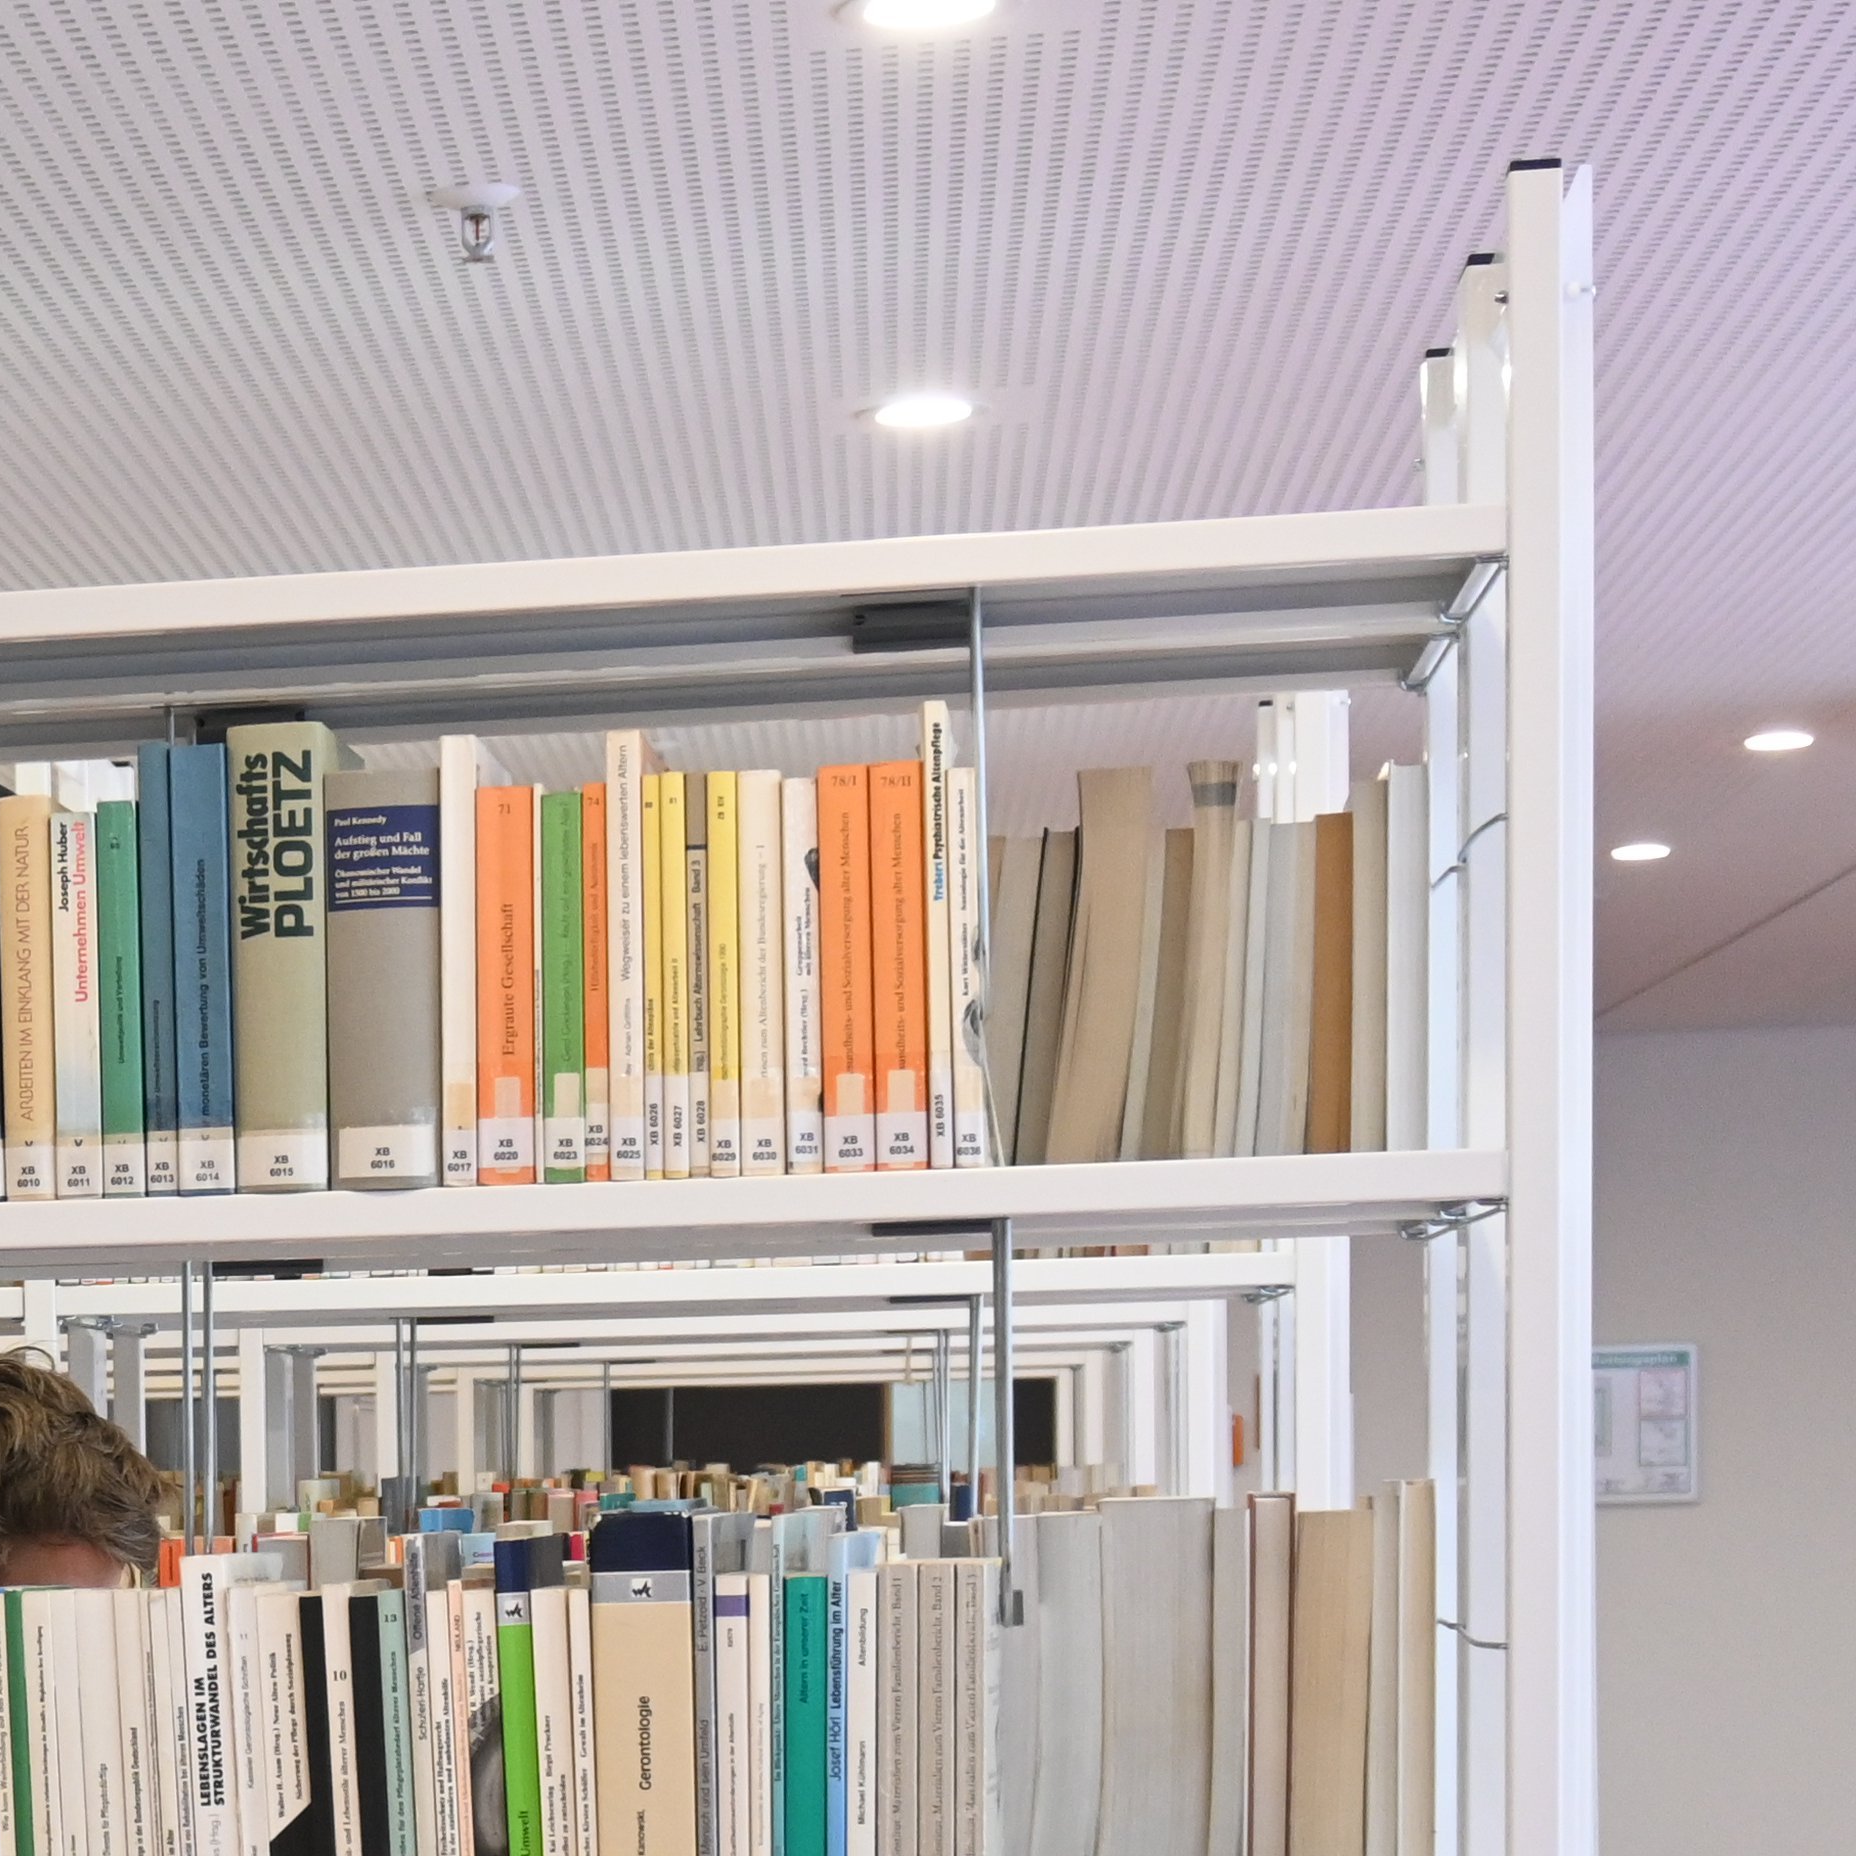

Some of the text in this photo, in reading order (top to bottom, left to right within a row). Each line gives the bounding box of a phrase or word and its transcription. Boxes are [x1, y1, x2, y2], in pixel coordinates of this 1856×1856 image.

[335, 831, 423, 848] Aufstieg und Fall
[498, 804, 511, 815] 71
[58, 822, 69, 912] Joseph Huber
[236, 751, 271, 940] Wirtschafts
[272, 749, 314, 938] PLOETZ
[334, 843, 430, 860] der großen Mächte
[72, 821, 88, 1002] Unternehmen Umwelt
[621, 867, 630, 898] einem
[621, 900, 630, 915] zu
[14, 828, 33, 1122] ARBEITEN IM EINKLANG MIT DER NATUR
[198, 957, 208, 980] von
[501, 903, 516, 1057] Ergraute Gesellschaft
[622, 918, 631, 982] Wegweiser
[198, 983, 210, 1049] Bewertung
[274, 1155, 290, 1164] XB
[375, 1147, 391, 1157] XB
[829, 1581, 843, 1610] Alter
[830, 1611, 843, 1624] im
[201, 1572, 225, 1805] STRUKTURWANDEL DES ALTERS
[829, 1625, 843, 1710] Lebensführung
[195, 1677, 212, 1807] LEBENSLAGEN IM
[639, 1696, 653, 1791] Gerontologie
